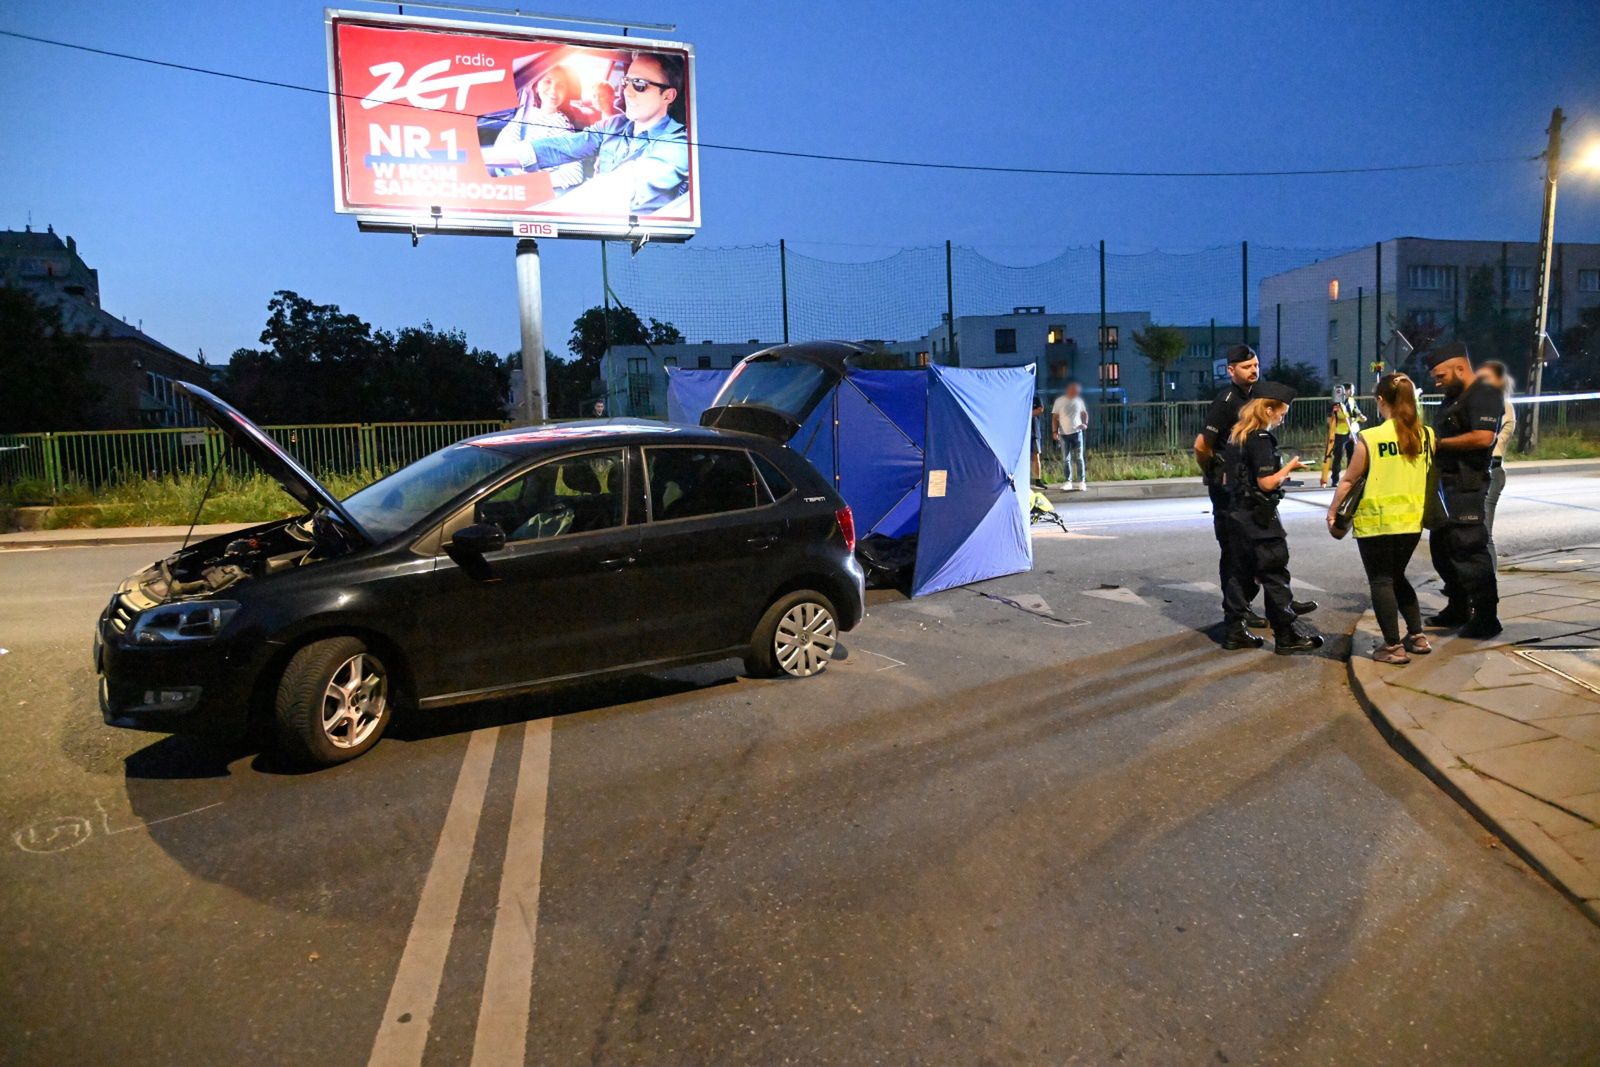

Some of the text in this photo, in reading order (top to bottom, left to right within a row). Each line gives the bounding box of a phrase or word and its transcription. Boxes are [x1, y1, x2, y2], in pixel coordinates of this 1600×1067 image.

[455, 53, 495, 67] radio
[360, 59, 506, 111] ZET
[368, 123, 458, 160] NR 1
[371, 161, 395, 178] W
[373, 179, 526, 201] SAMOCHODZIE
[519, 223, 552, 235] ams
